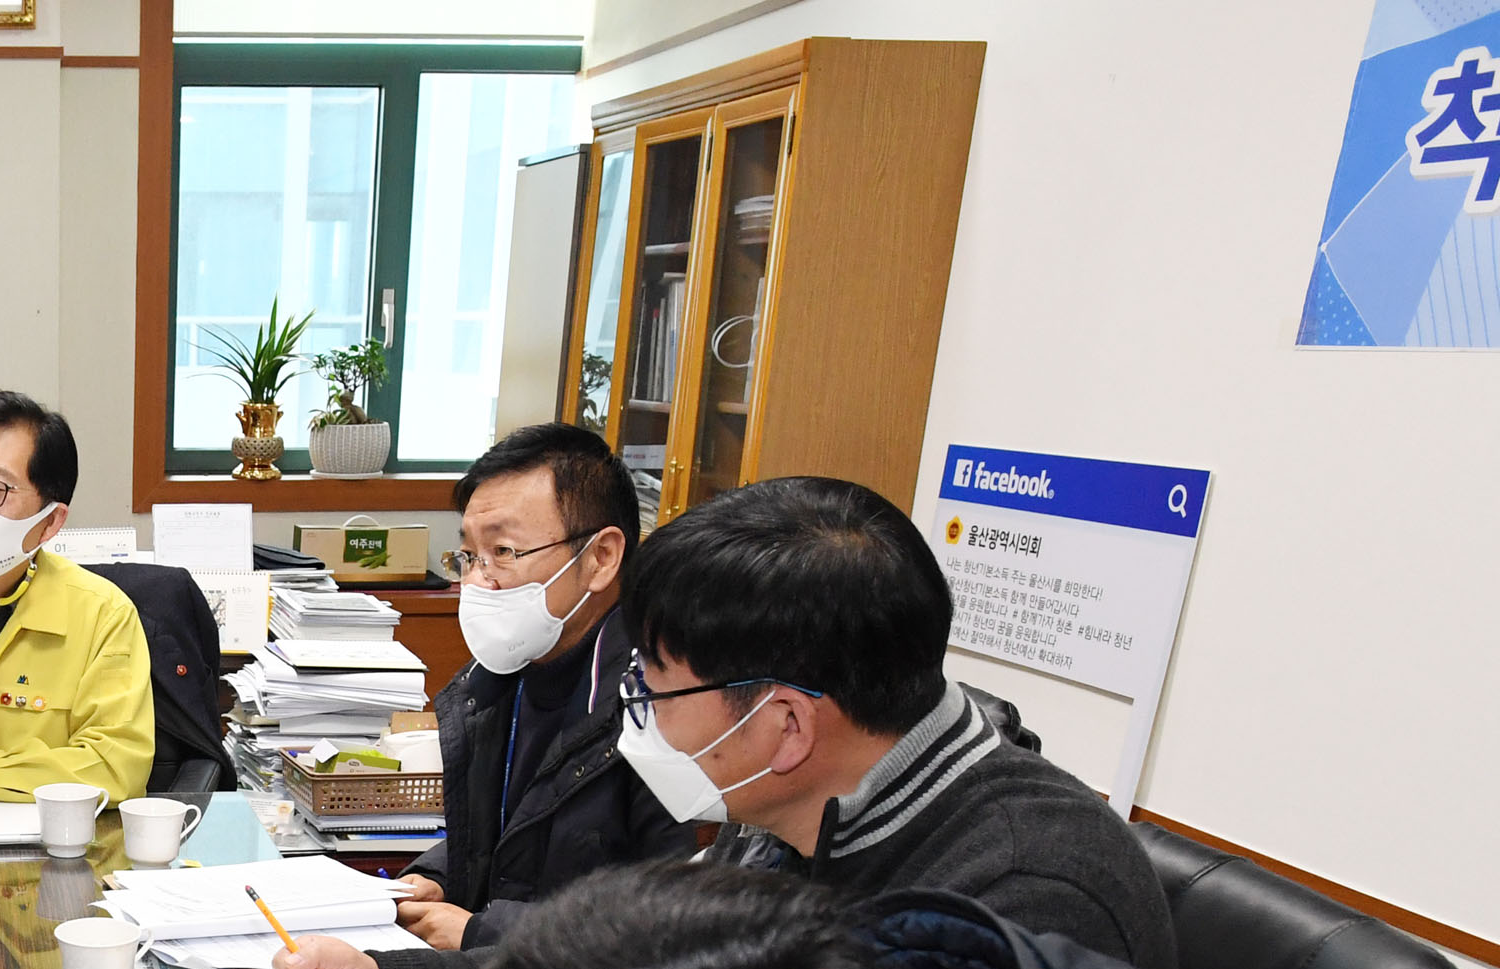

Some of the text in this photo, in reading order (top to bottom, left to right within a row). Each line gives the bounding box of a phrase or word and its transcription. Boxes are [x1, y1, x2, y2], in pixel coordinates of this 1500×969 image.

[974, 462, 1051, 498] facebook
[54, 543, 67, 553] 01
[967, 525, 1043, 558] 울산광역시의회
[947, 557, 1104, 601] 나는 청년기본소득 주는 울산시를 희망한다!
[1011, 590, 1027, 606] 함께
[1029, 595, 1080, 618] 만들어갑시다
[969, 597, 1009, 617] 응원합니다
[1020, 609, 1054, 629] 함께가자
[1056, 618, 1073, 635] 청춘
[1078, 625, 1112, 645] #힘내라
[1114, 632, 1133, 651] 청년
[973, 614, 997, 631] 청년의
[997, 621, 1014, 637] 꿈을
[1015, 625, 1057, 646] 응원합니다
[970, 629, 1002, 650] 절약해서
[1003, 639, 1037, 660] 청년예산
[1038, 648, 1073, 670] 확대하자
